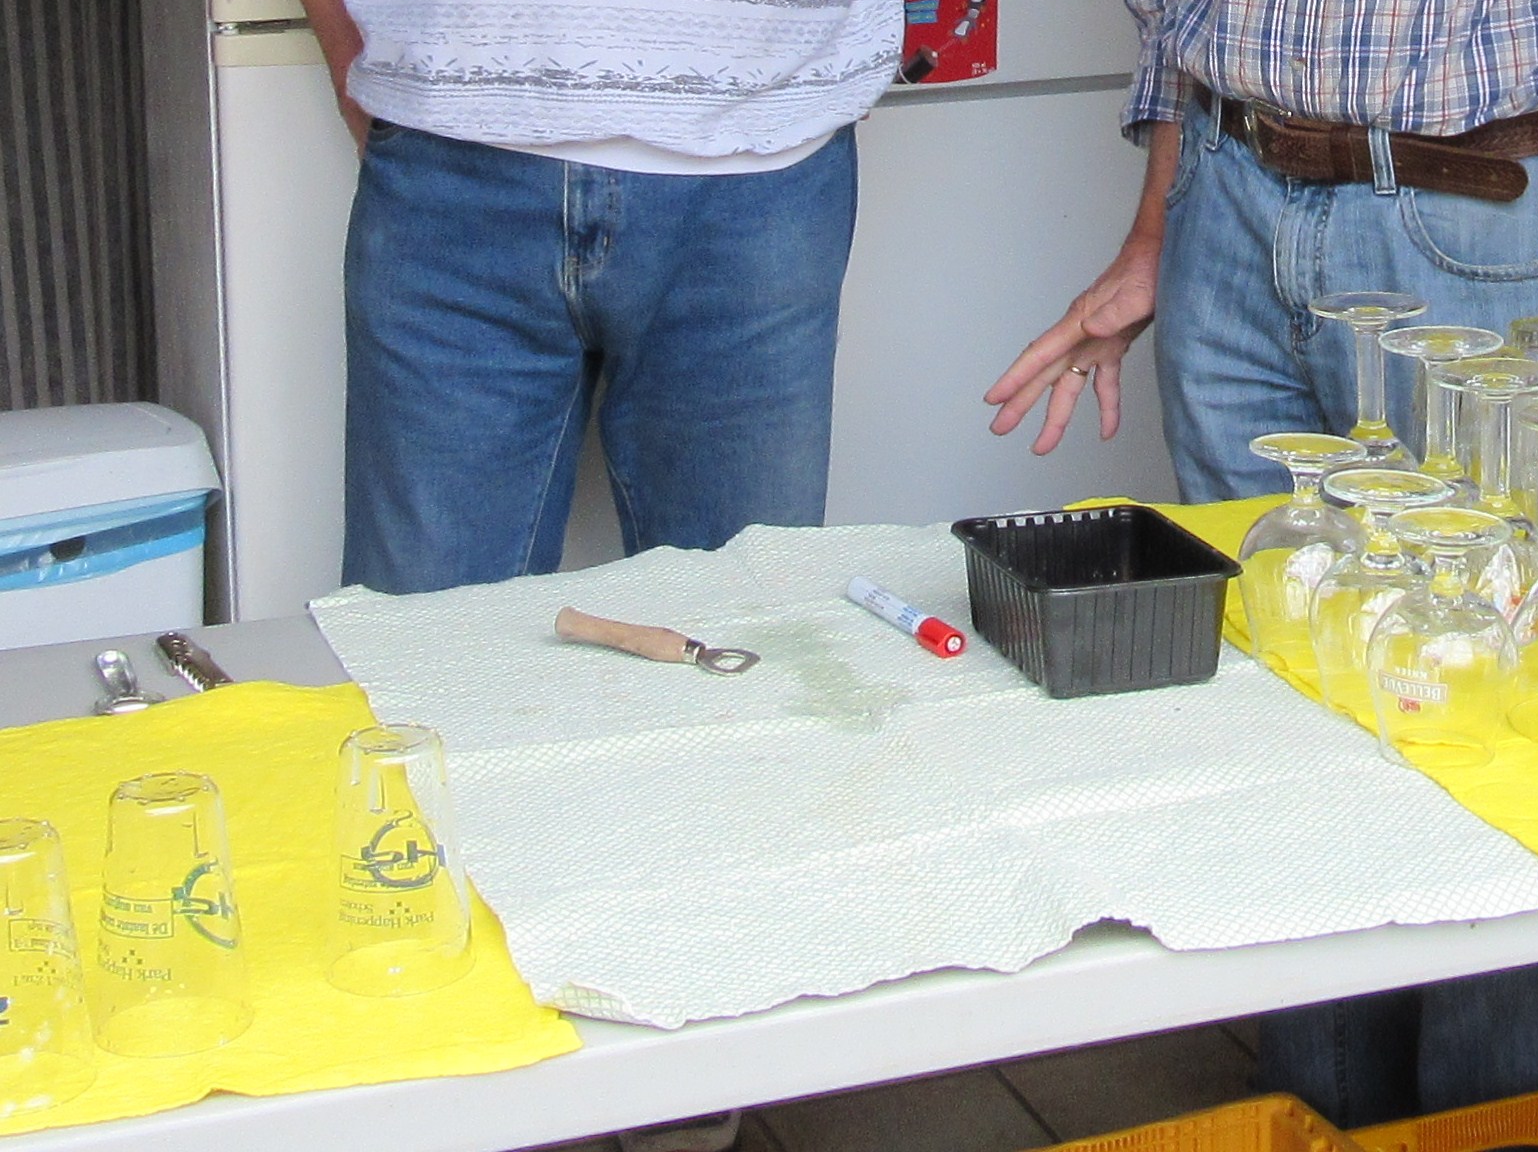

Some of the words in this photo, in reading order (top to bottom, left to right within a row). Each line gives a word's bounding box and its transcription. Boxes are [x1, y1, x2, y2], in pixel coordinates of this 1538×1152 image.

[1382, 676, 1441, 700] BELLEVUE
[405, 910, 435, 928] Park
[136, 967, 172, 982] Park
